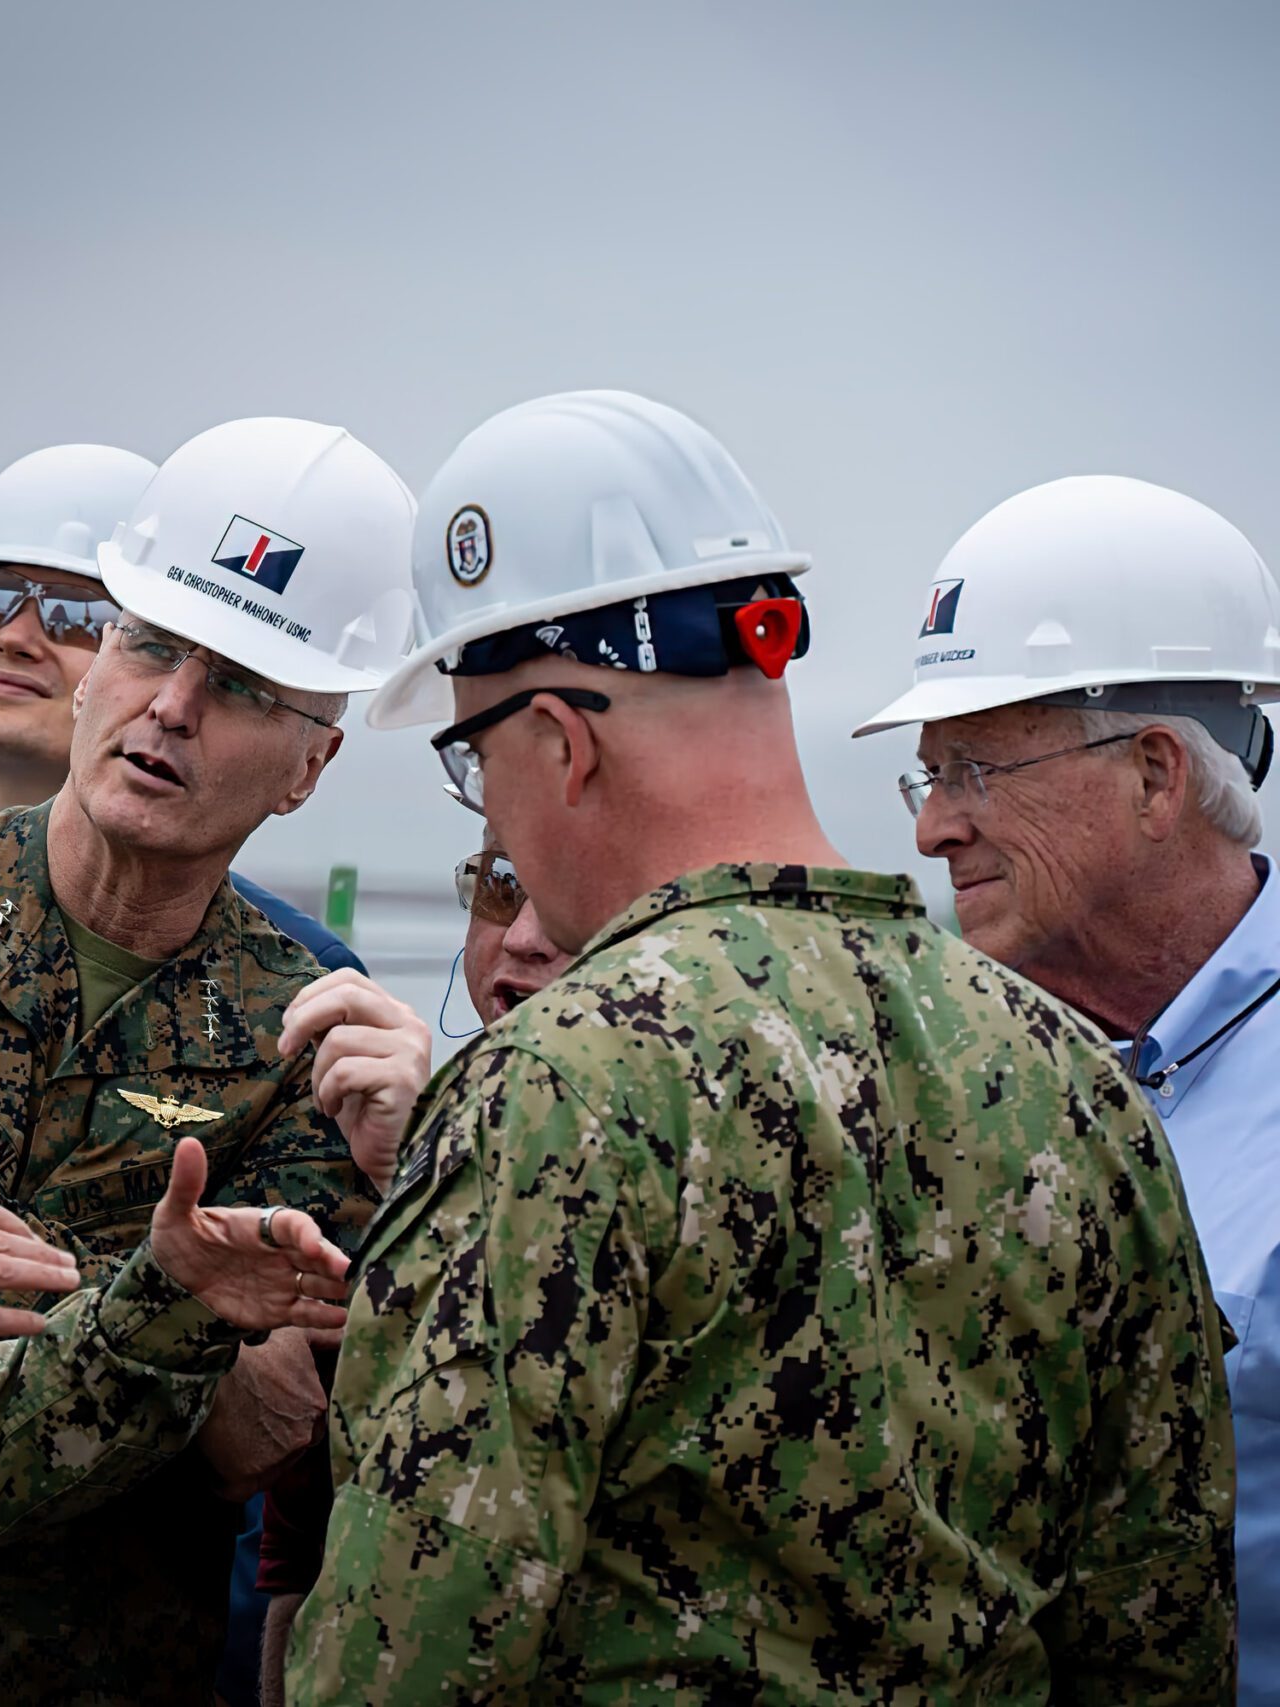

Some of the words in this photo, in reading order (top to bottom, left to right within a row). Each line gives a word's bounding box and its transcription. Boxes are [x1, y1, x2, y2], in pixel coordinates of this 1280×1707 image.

[167, 566, 184, 582] GEN
[184, 573, 241, 608] CHRISTOPHER
[242, 600, 287, 630] MAHONEY
[287, 621, 311, 643] USMC
